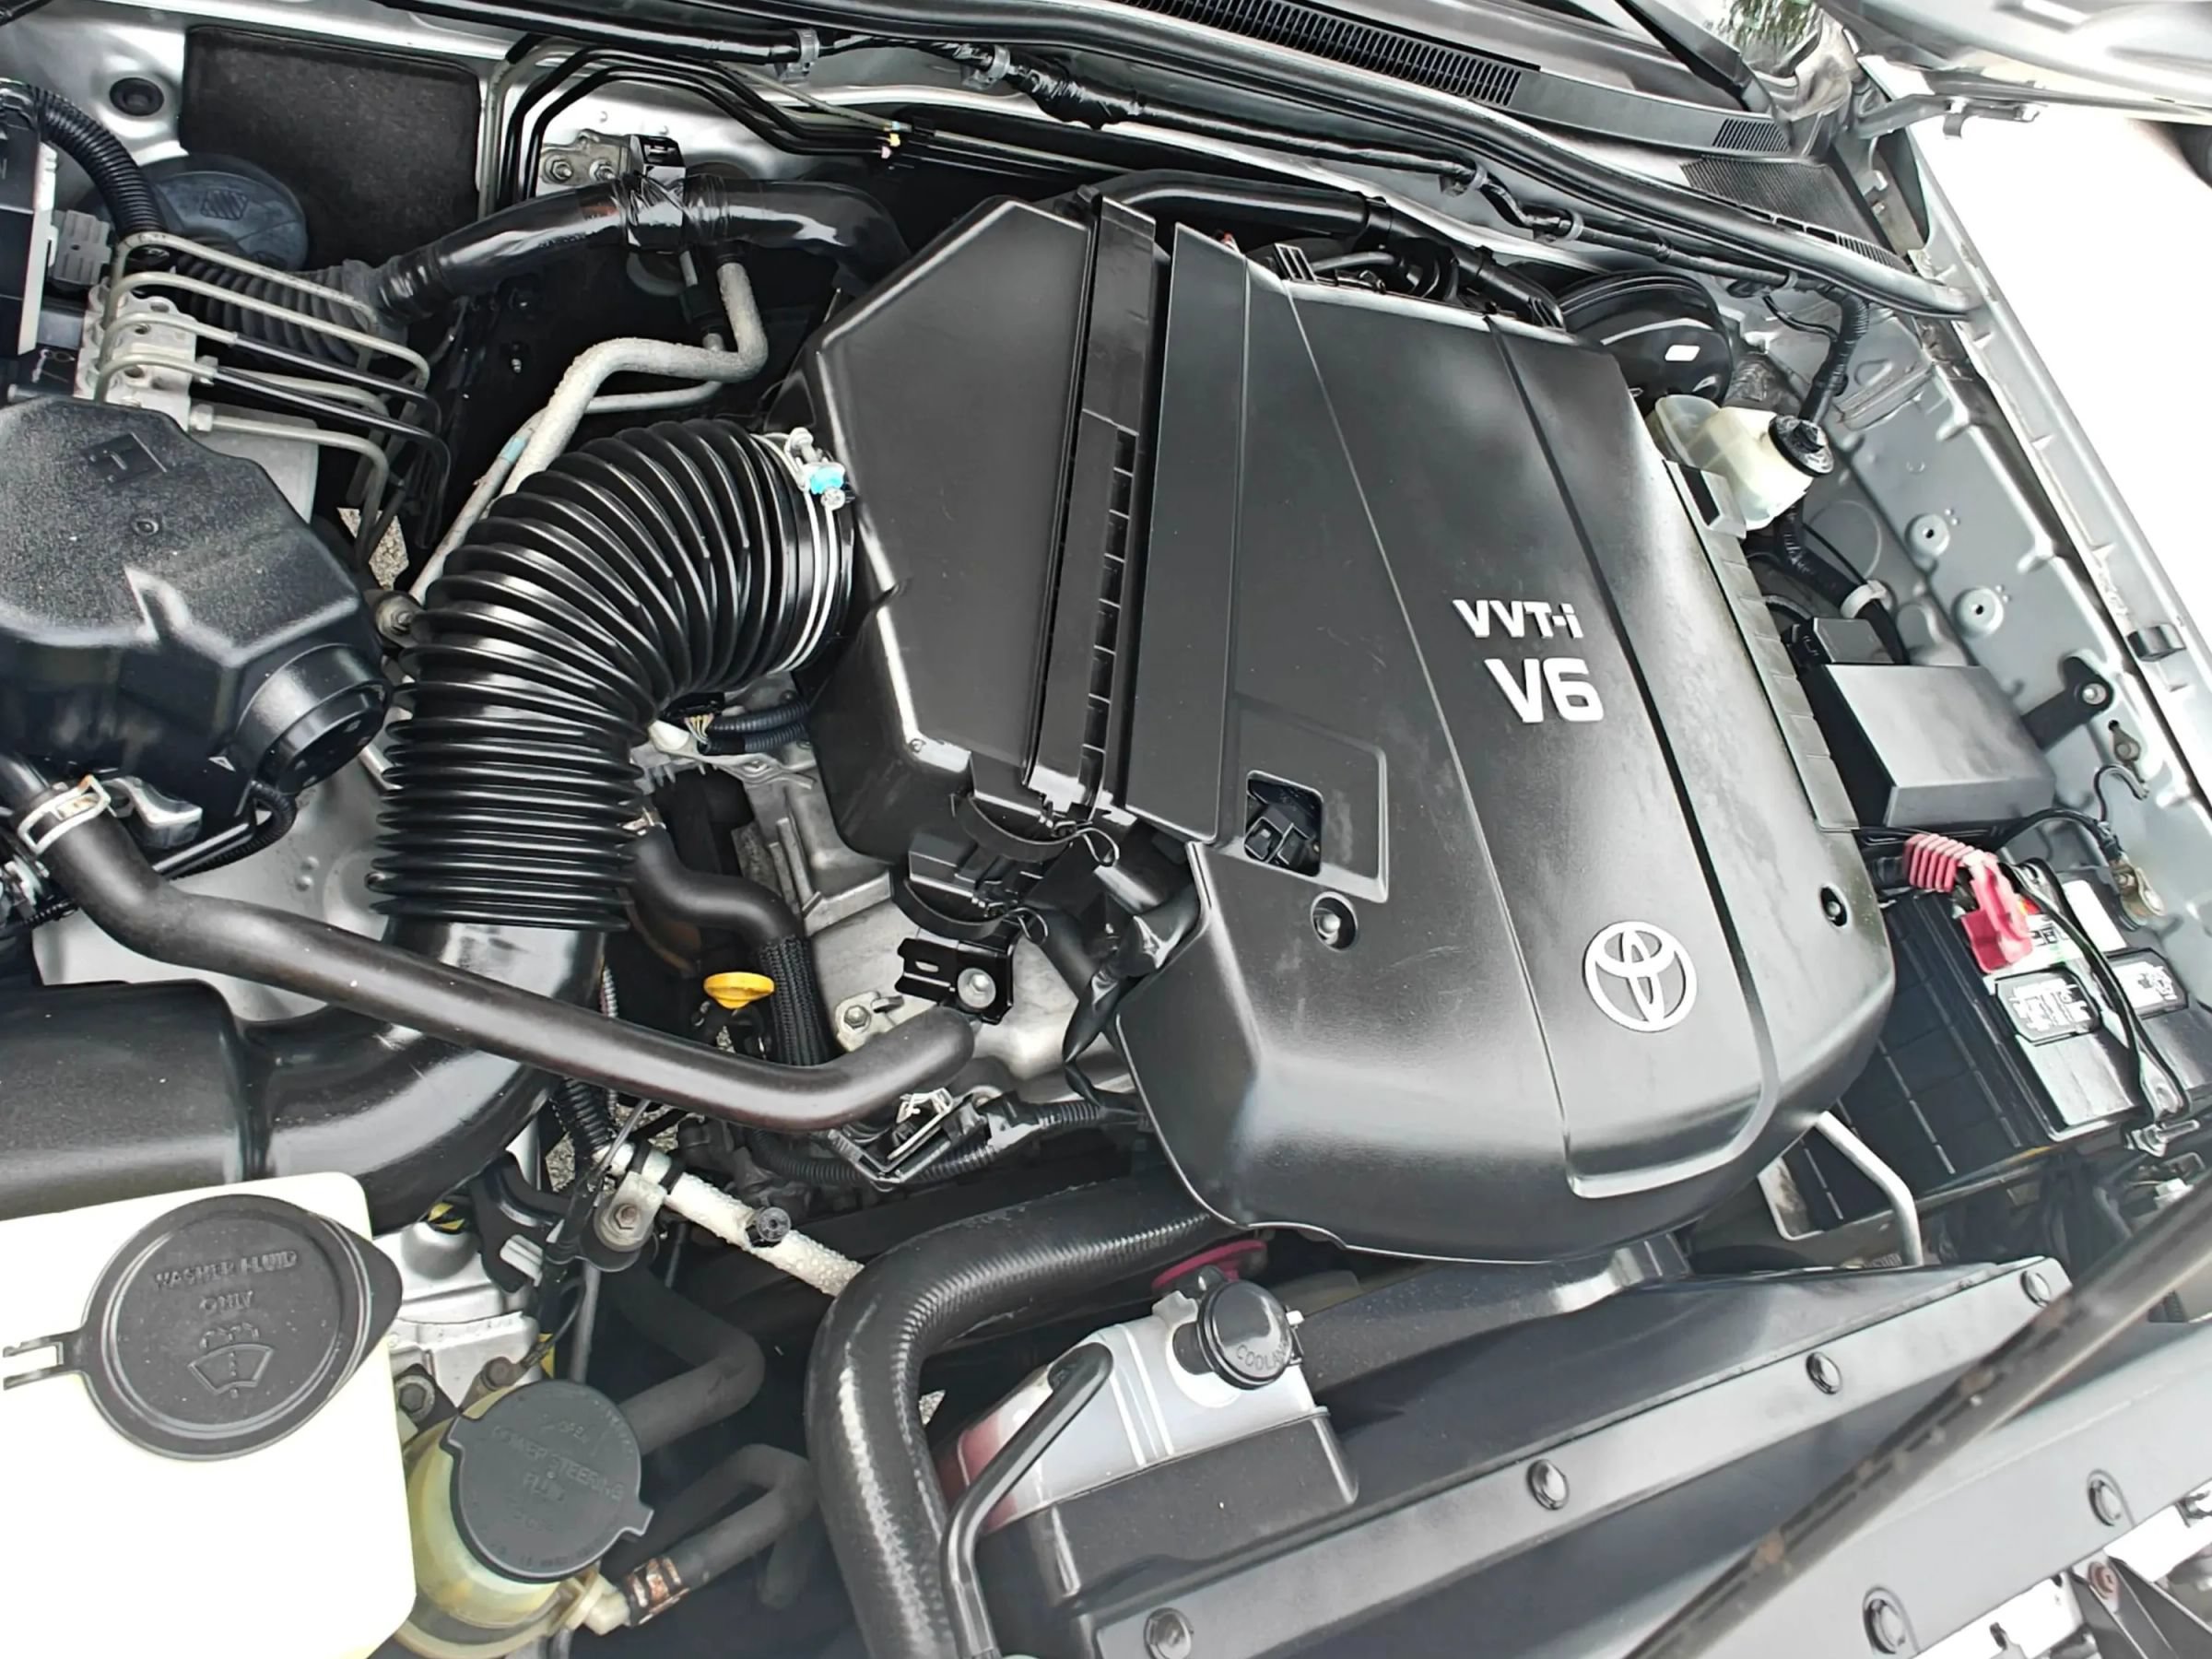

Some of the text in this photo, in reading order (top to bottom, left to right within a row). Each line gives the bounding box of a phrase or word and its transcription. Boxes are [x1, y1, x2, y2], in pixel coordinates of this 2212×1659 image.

[1452, 599, 1583, 639] VVT-i
[1483, 657, 1605, 724] V6
[154, 1250, 298, 1291] WASHER FLUID
[199, 1289, 253, 1315] ONLY
